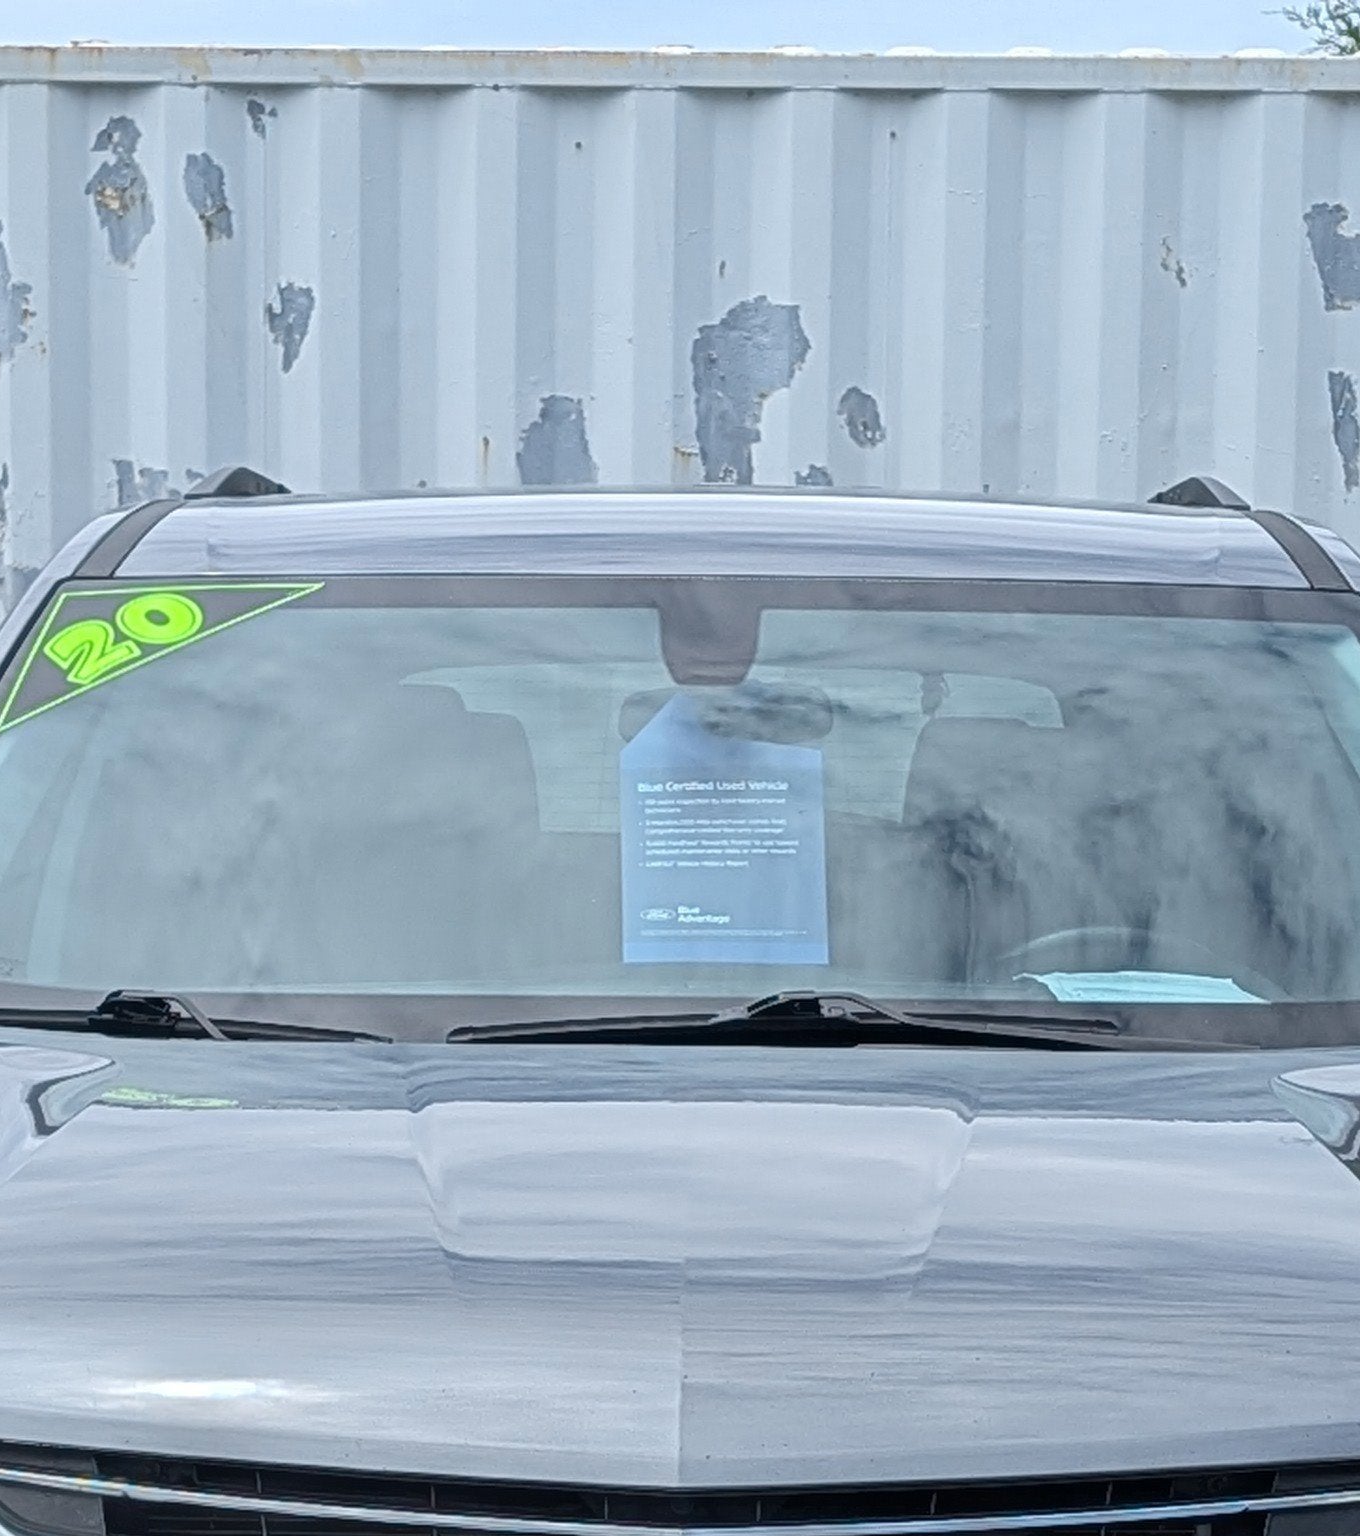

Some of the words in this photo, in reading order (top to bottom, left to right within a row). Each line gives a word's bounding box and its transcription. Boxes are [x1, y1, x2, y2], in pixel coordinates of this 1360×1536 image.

[43, 593, 203, 685] 20
[637, 782, 664, 793] Blue
[665, 780, 714, 792] Certified
[716, 780, 746, 791] Used
[747, 780, 790, 791] Vehicle
[677, 906, 700, 914] Blue
[677, 914, 731, 924] Advantage
